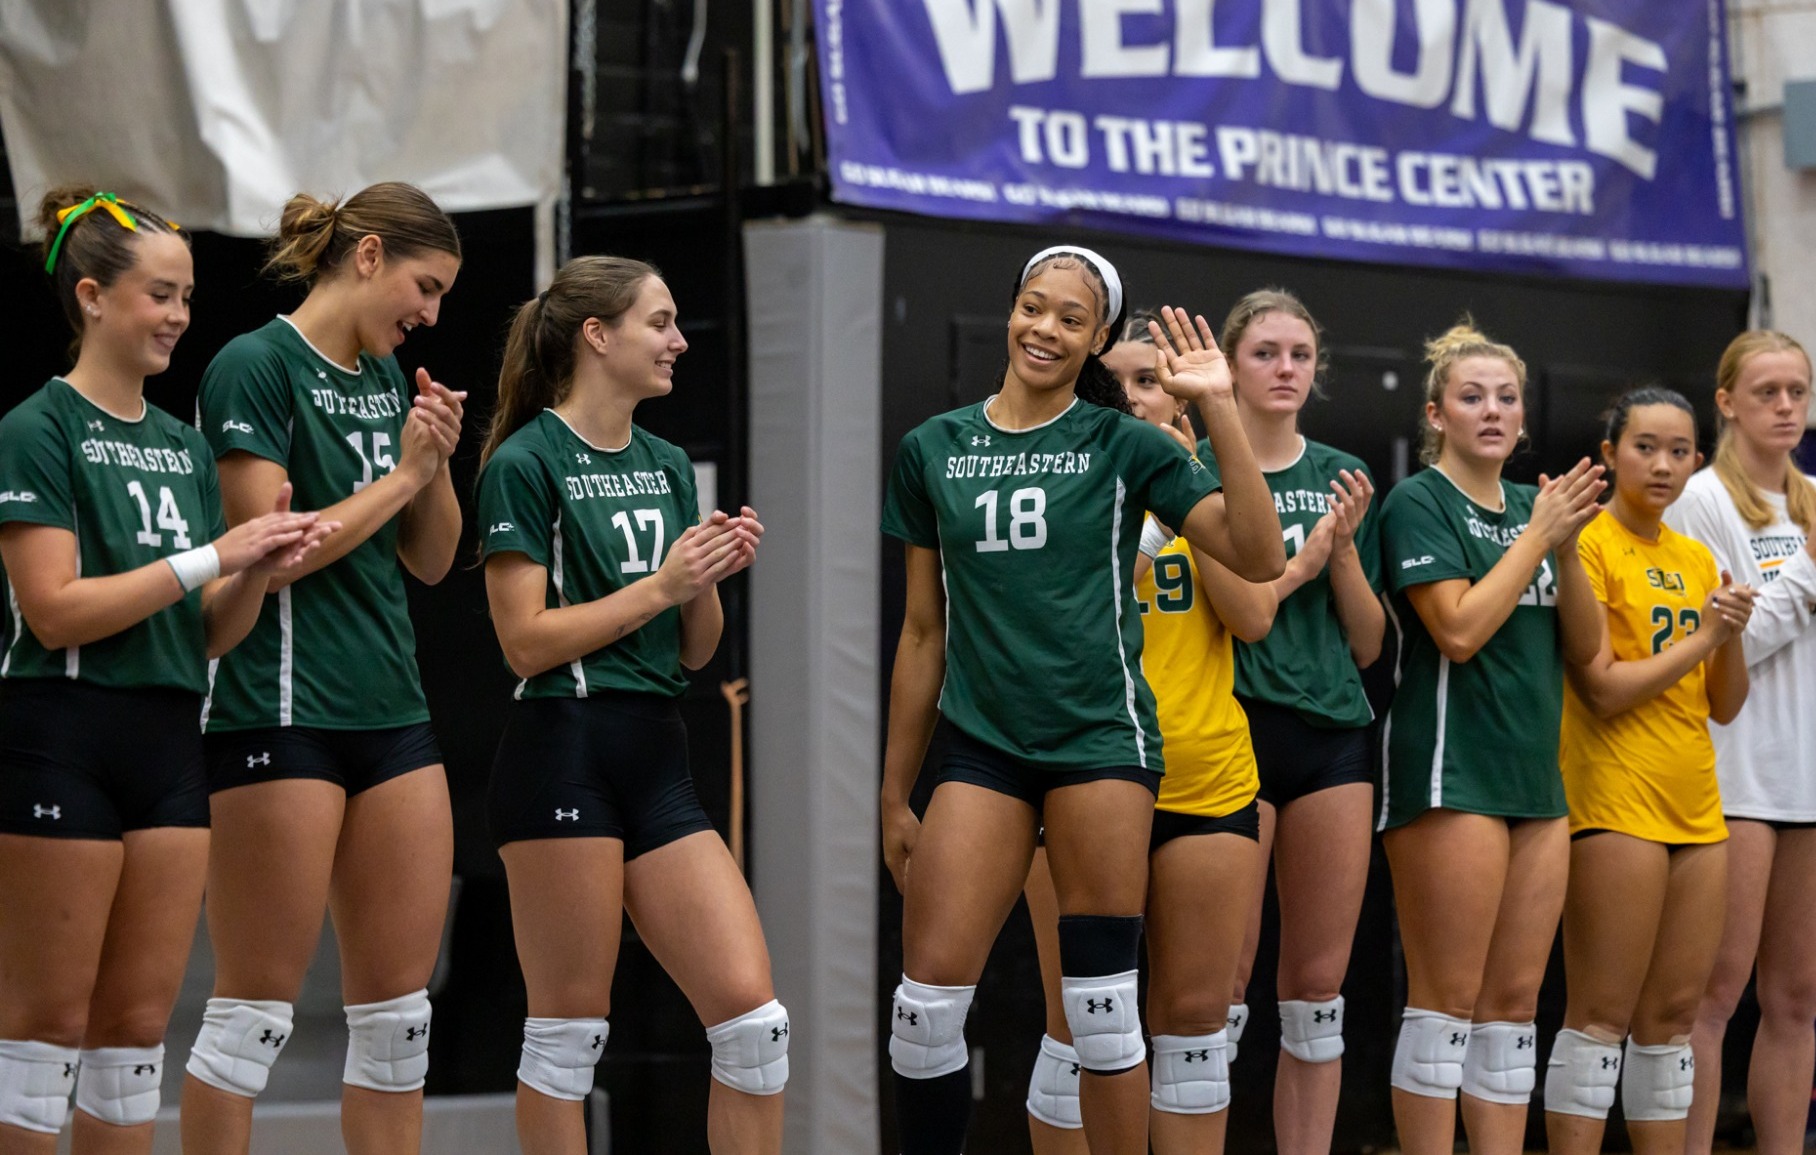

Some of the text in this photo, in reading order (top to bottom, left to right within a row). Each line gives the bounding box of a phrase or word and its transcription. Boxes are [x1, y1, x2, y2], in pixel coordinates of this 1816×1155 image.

[923, 0, 1668, 180] WELCOME
[1009, 105, 1089, 168] TO
[1095, 117, 1214, 177] THE
[1216, 127, 1396, 204] PRINCE
[1397, 151, 1596, 215] CENTER
[346, 432, 397, 493] 15
[565, 470, 672, 500] SOUTHEASTER
[946, 452, 1091, 480] SOUTHEASTERN
[126, 480, 192, 549] 14
[610, 508, 665, 574] 17
[975, 487, 1048, 553] 18
[1138, 553, 1195, 614] 9
[1516, 556, 1558, 606] 2
